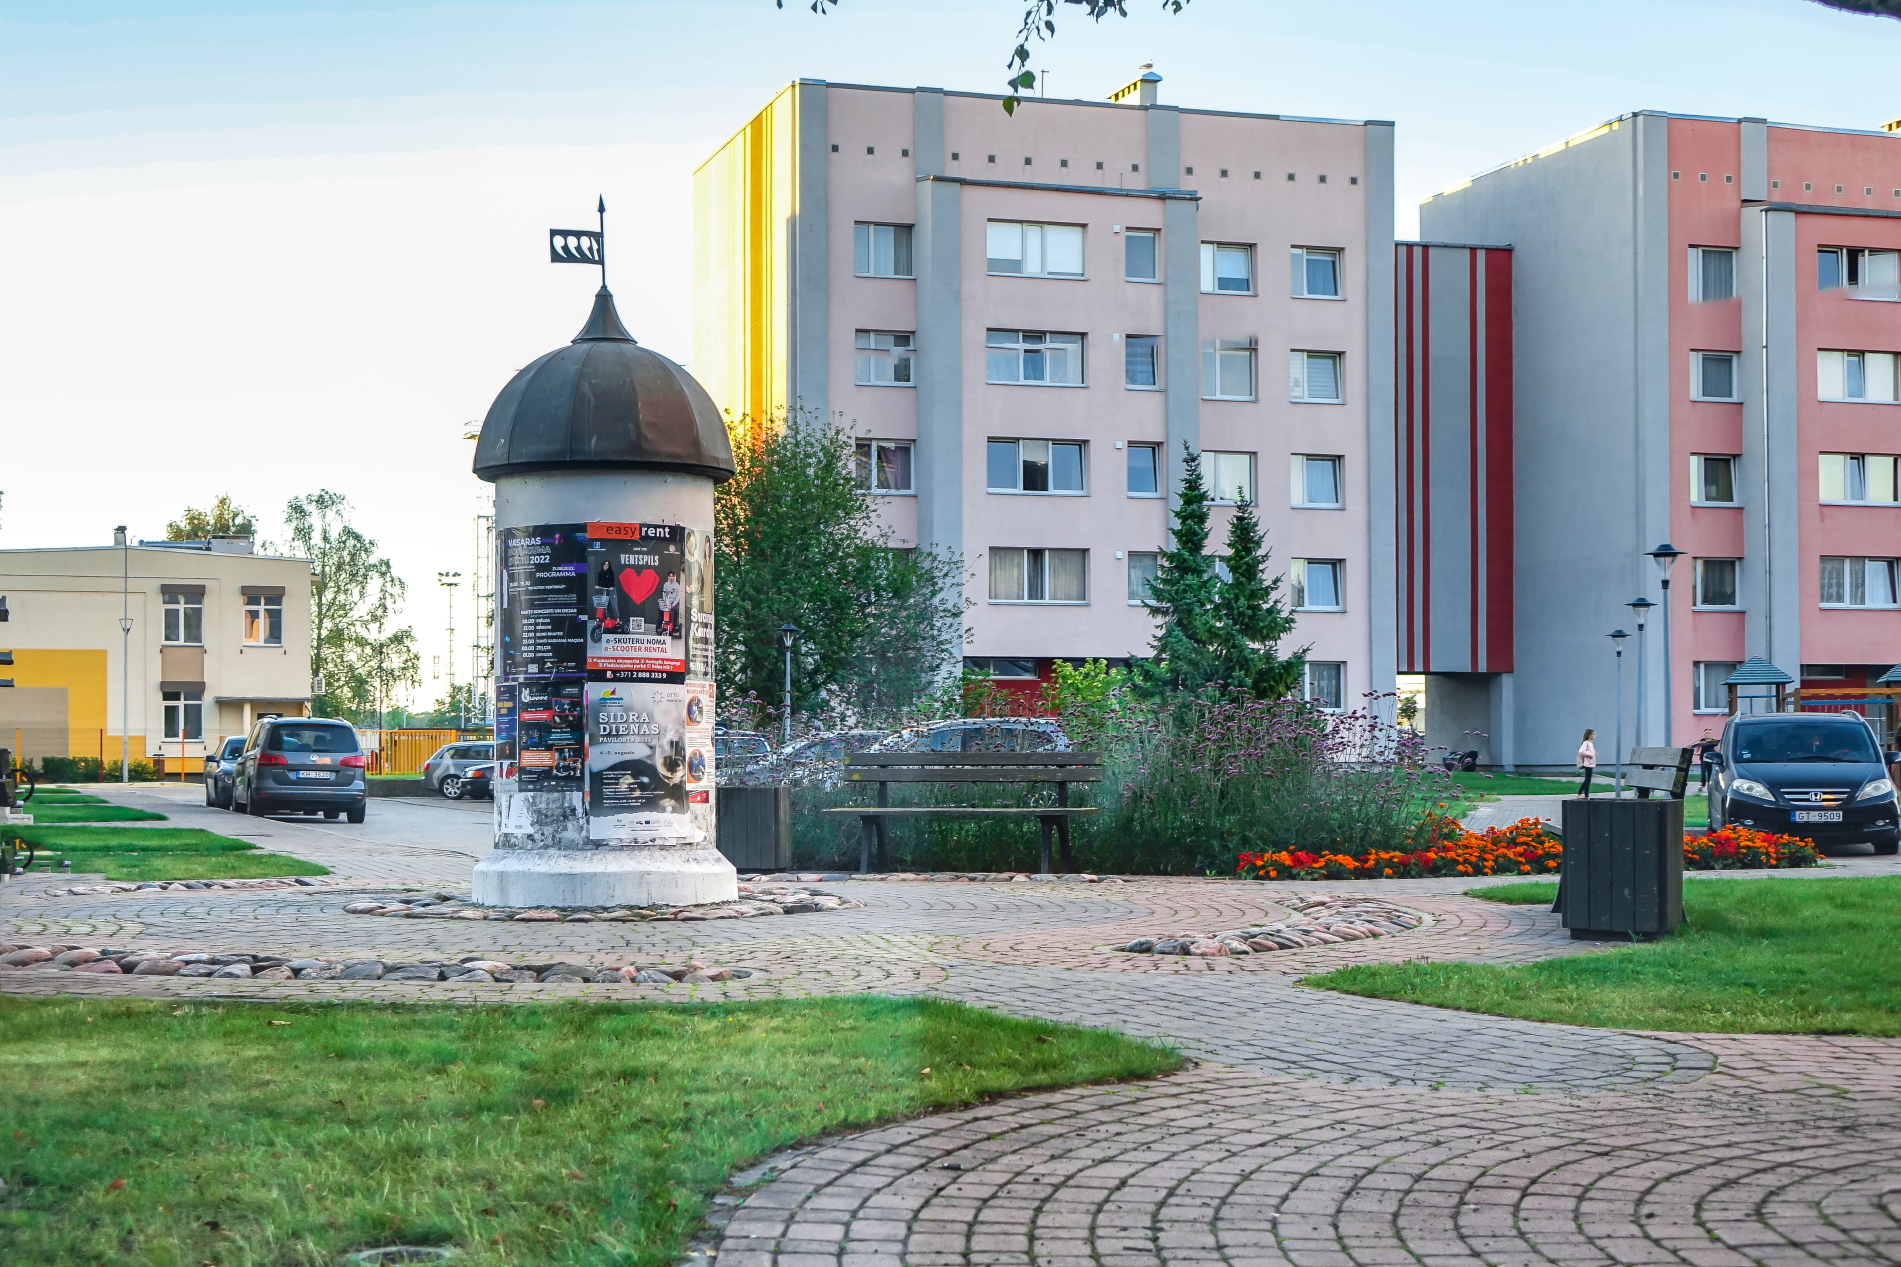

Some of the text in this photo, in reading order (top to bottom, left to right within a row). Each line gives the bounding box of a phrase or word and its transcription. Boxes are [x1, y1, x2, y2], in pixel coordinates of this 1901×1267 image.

[606, 525, 670, 538] easy rent
[508, 537, 542, 547] VASARAS
[530, 555, 550, 564] 2022
[620, 554, 659, 566] VENTSPILS
[605, 636, 667, 646] e-SKŪTERU NOMA
[604, 645, 642, 653] e-SCOOTER
[599, 712, 650, 723] SIDRA
[599, 724, 660, 735] DIENAS
[1798, 812, 1841, 820] GT-9509
